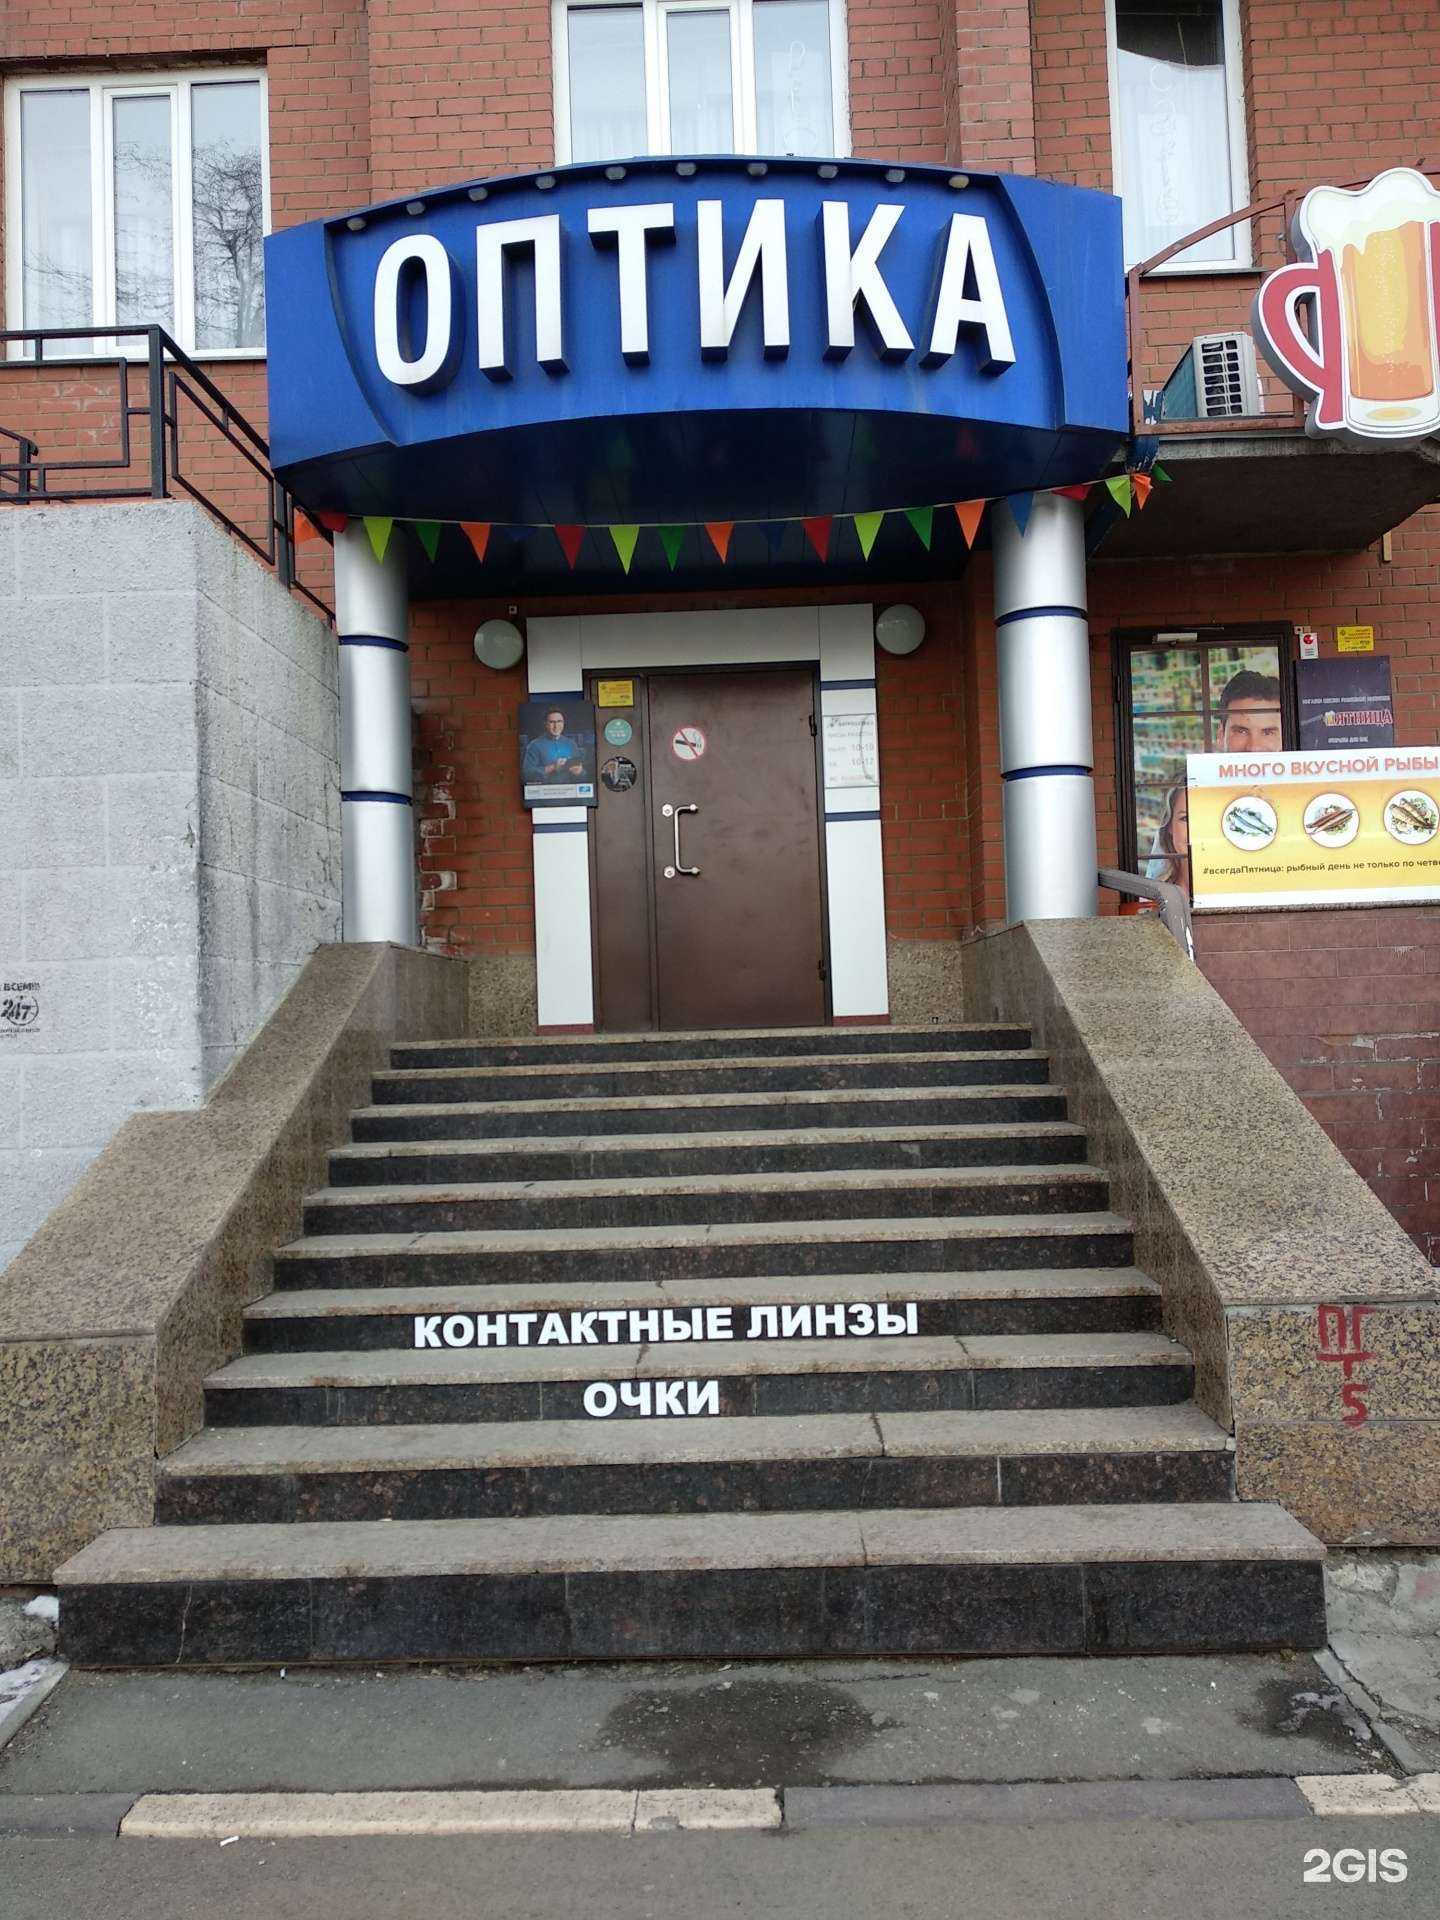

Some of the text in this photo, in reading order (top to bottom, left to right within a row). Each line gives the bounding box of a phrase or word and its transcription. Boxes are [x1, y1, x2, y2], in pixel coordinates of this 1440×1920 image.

[373, 198, 1017, 388] ОПТИКА
[1218, 755, 1439, 778] МНОГО ВКУСНОЙ РЫБЫ
[1202, 865, 1285, 875] #всегдаПятница:
[1286, 863, 1326, 873] рыбный
[1327, 863, 1351, 871] день
[1367, 860, 1400, 869] только
[413, 1302, 919, 1348] КОНТАКТНЫЕ ЛИНЗЫ
[583, 1380, 721, 1418] ОЧКИ
